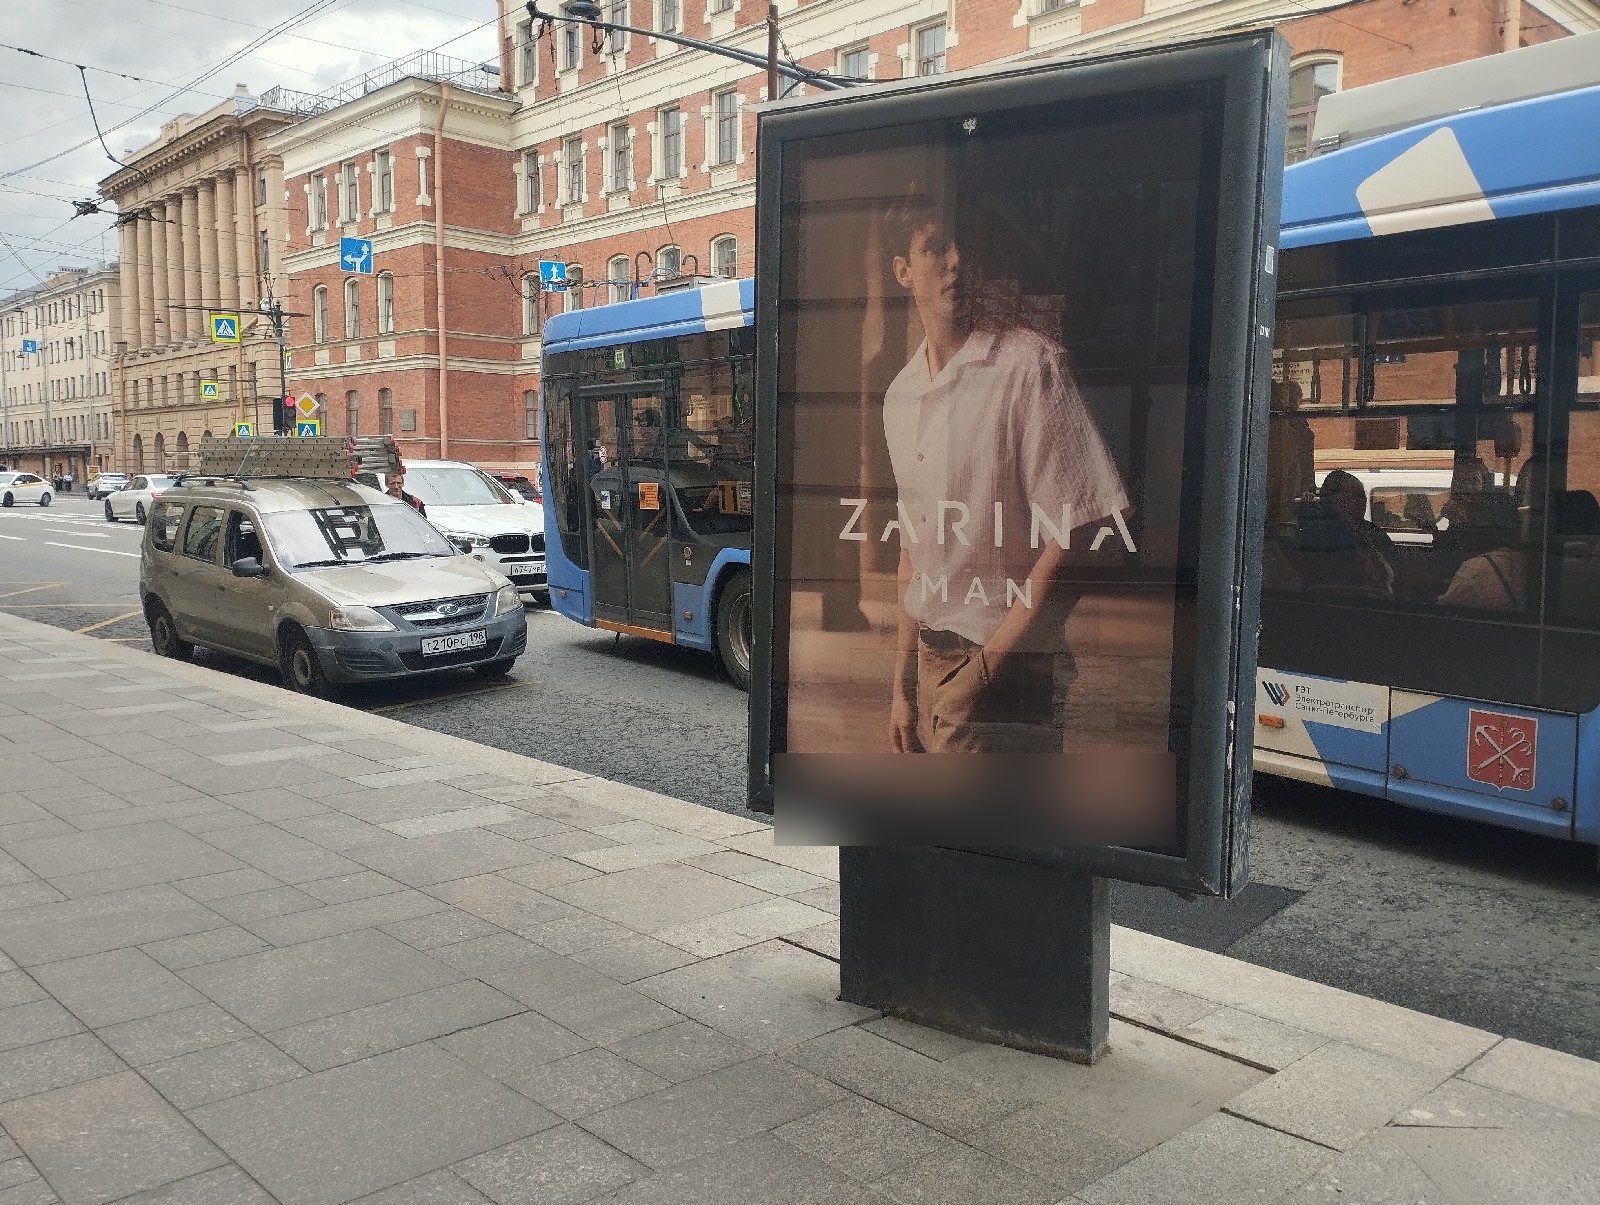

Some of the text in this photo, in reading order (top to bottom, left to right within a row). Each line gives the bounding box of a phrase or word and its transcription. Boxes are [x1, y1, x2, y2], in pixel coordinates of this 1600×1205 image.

[838, 498, 1137, 553] ZARINA
[920, 573, 1032, 609] MAN
[1295, 702, 1375, 722] Санкт-Петербурга
